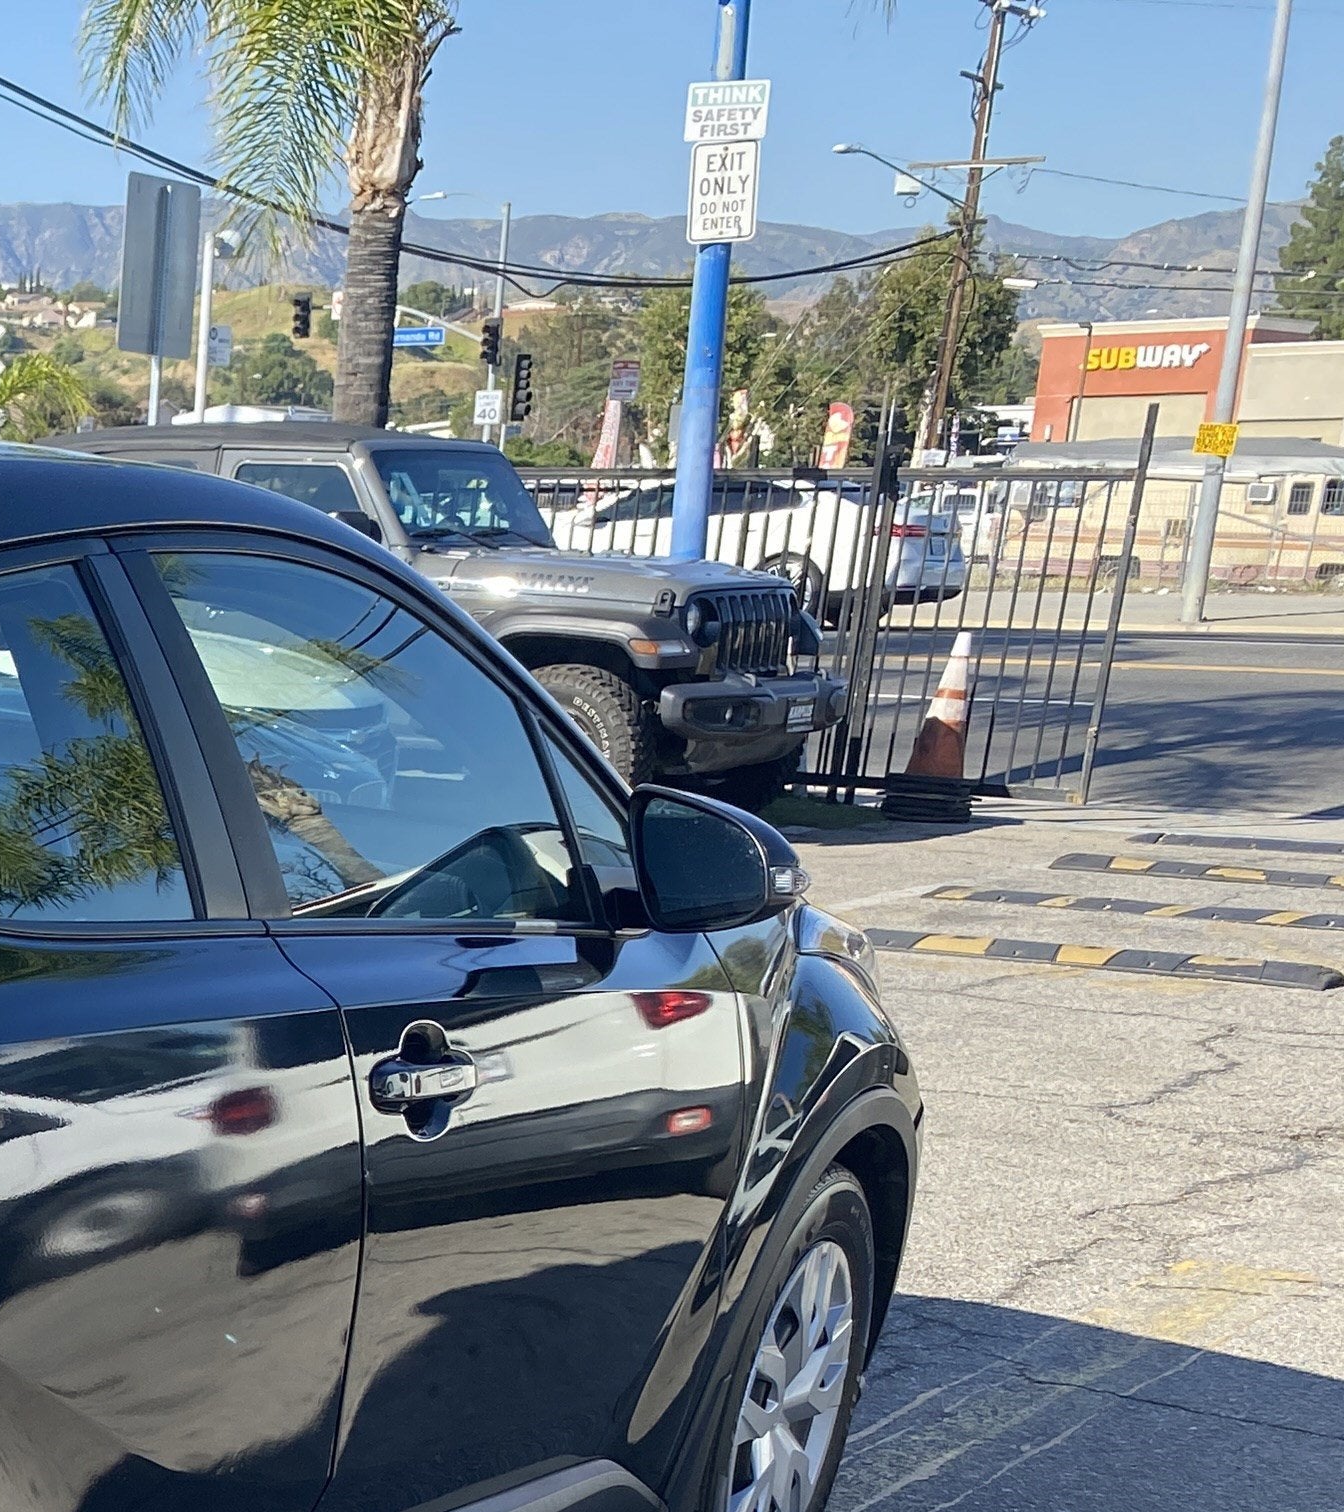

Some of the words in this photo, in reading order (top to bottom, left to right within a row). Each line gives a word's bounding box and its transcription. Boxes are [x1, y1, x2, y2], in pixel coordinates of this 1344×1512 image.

[694, 84, 763, 106] THINK
[691, 106, 762, 123] SAFETY
[699, 122, 752, 138] FIRST
[706, 151, 746, 173] EXIT
[699, 174, 750, 197] ONLY
[700, 202, 717, 215] DO
[722, 199, 746, 213] NOT
[702, 215, 742, 231] ENTER
[1080, 342, 1212, 372] SUBWAY
[476, 408, 497, 420] 40
